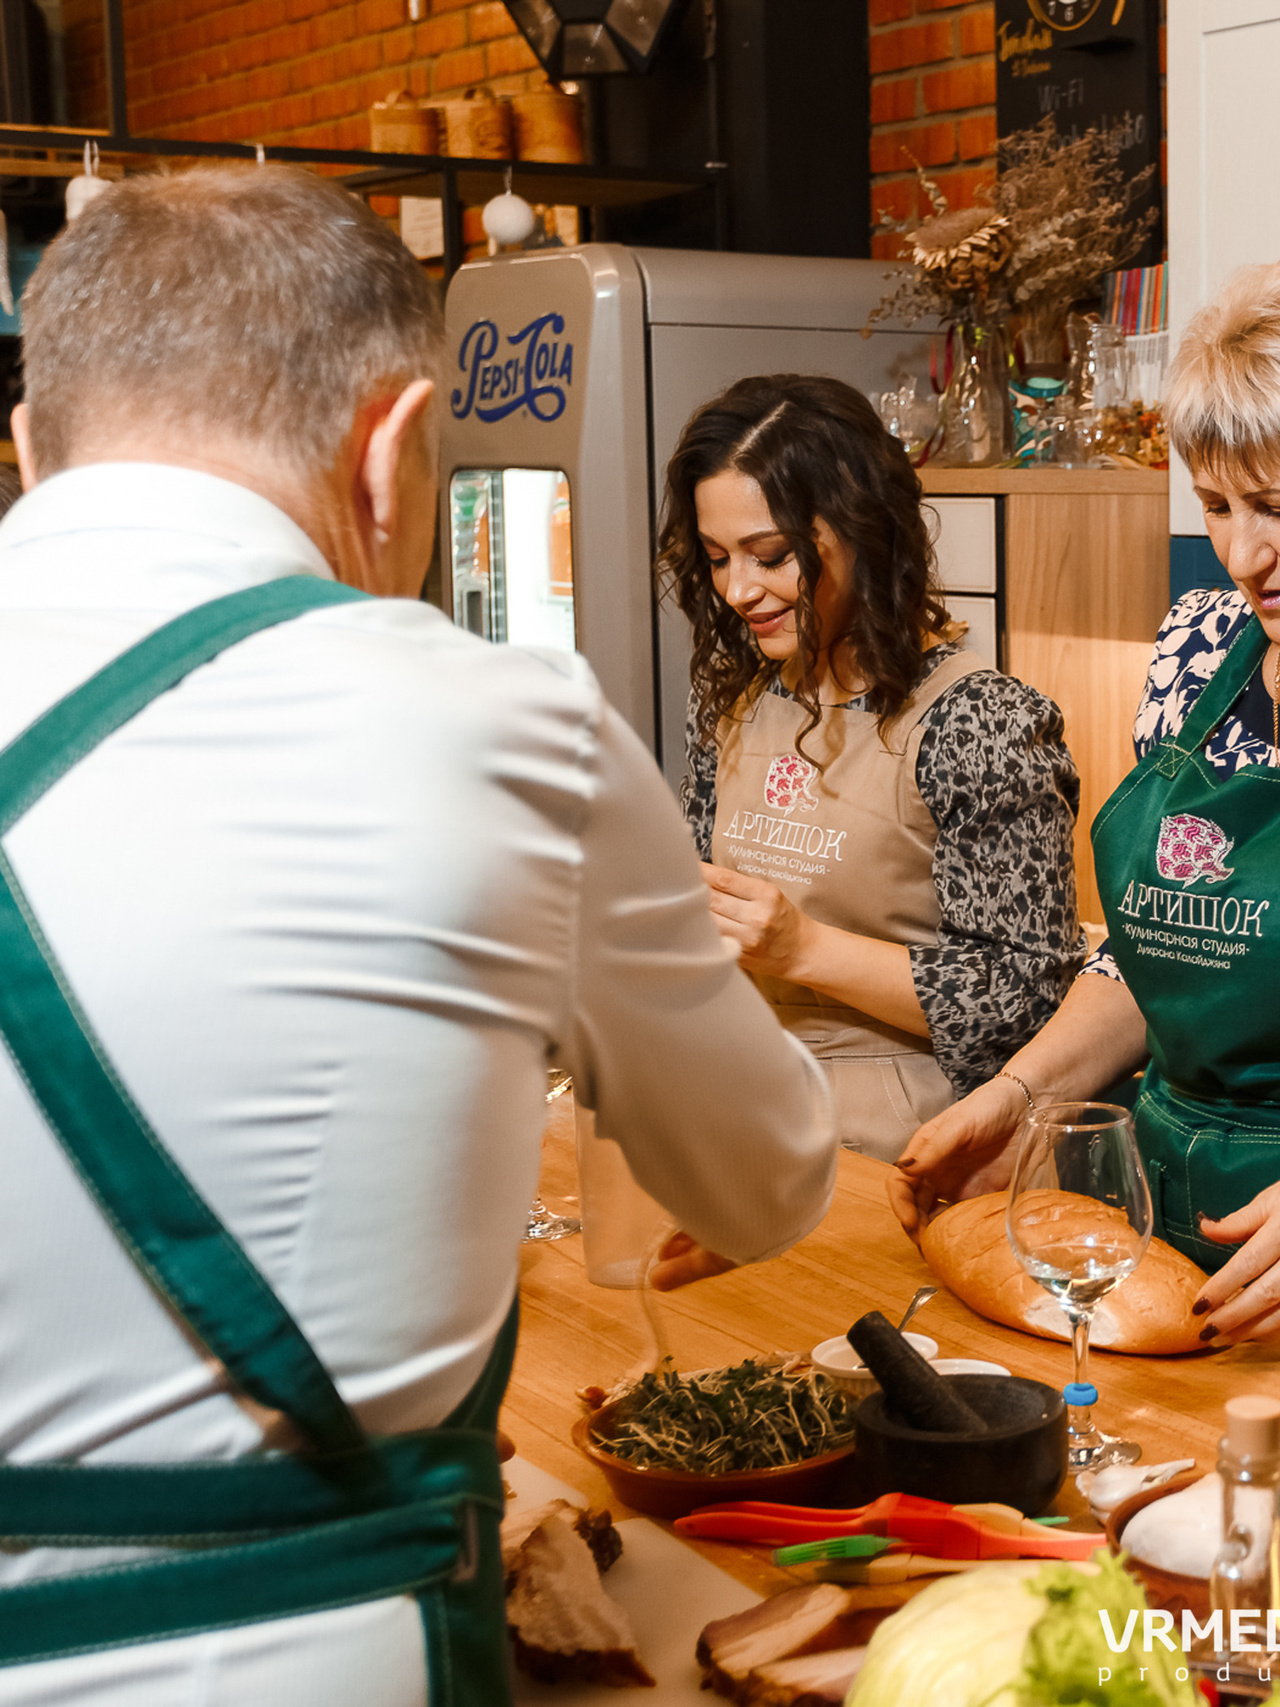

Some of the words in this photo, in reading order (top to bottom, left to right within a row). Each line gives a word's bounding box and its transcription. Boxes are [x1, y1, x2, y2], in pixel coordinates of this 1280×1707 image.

[451, 312, 573, 423] PEPSI-COLA
[722, 809, 847, 862] АРТИШОК
[1117, 879, 1270, 938] АРТИШОК
